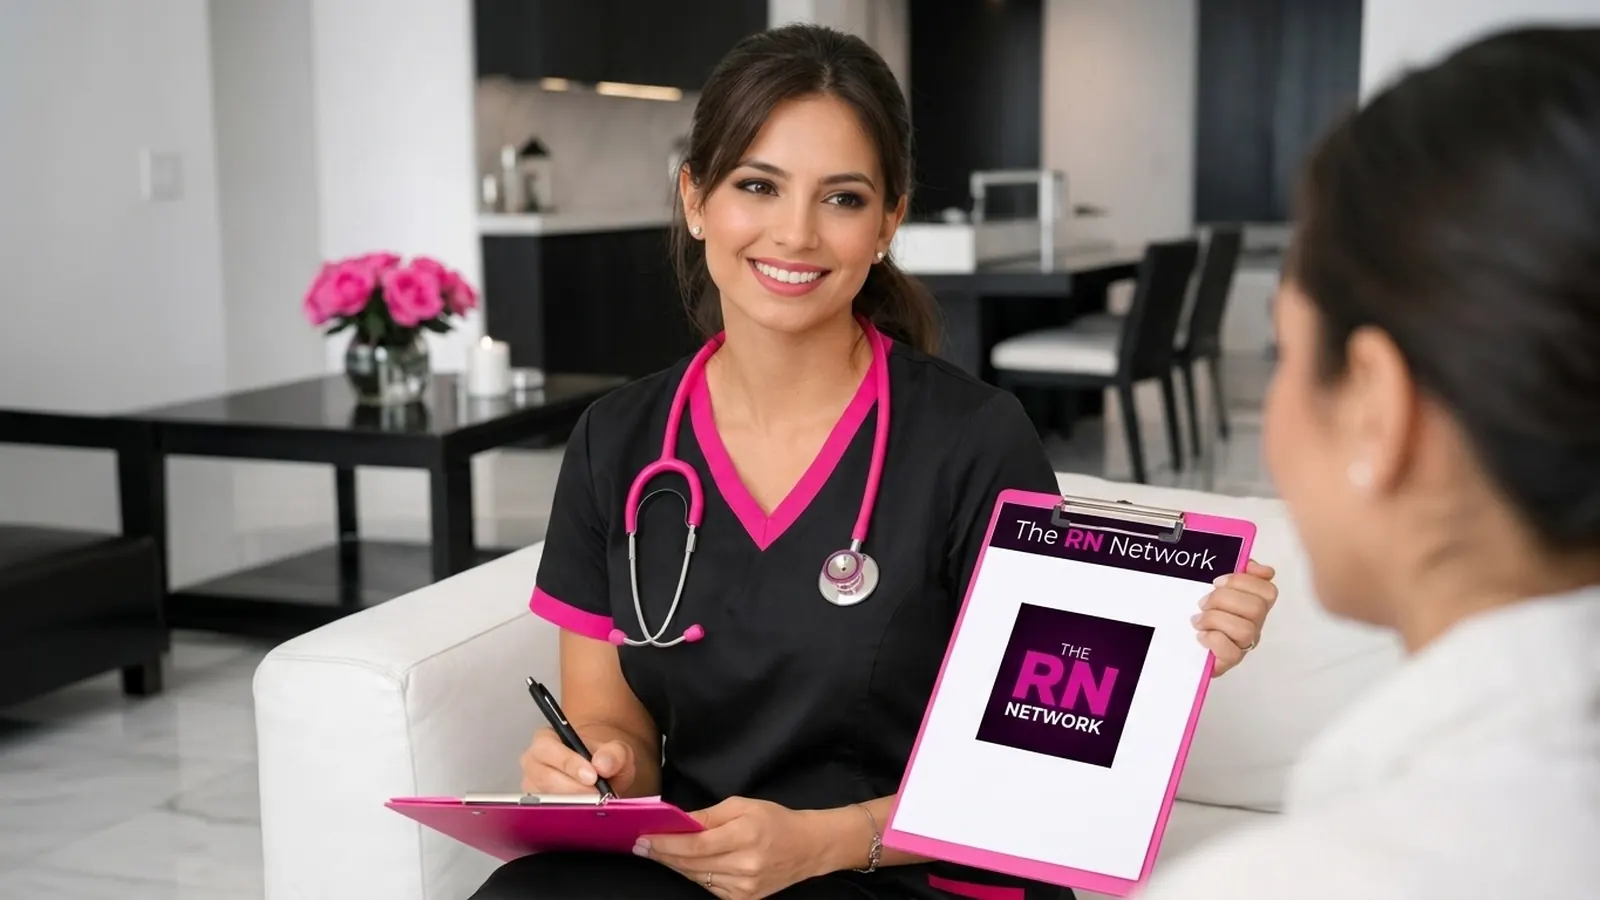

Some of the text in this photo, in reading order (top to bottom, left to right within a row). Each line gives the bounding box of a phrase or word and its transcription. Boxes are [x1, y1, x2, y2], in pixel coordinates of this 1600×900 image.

[1016, 519, 1217, 571] The RN Network
[1060, 642, 1092, 661] THE
[1012, 649, 1120, 717] RN
[1004, 701, 1105, 735] NETWORK
